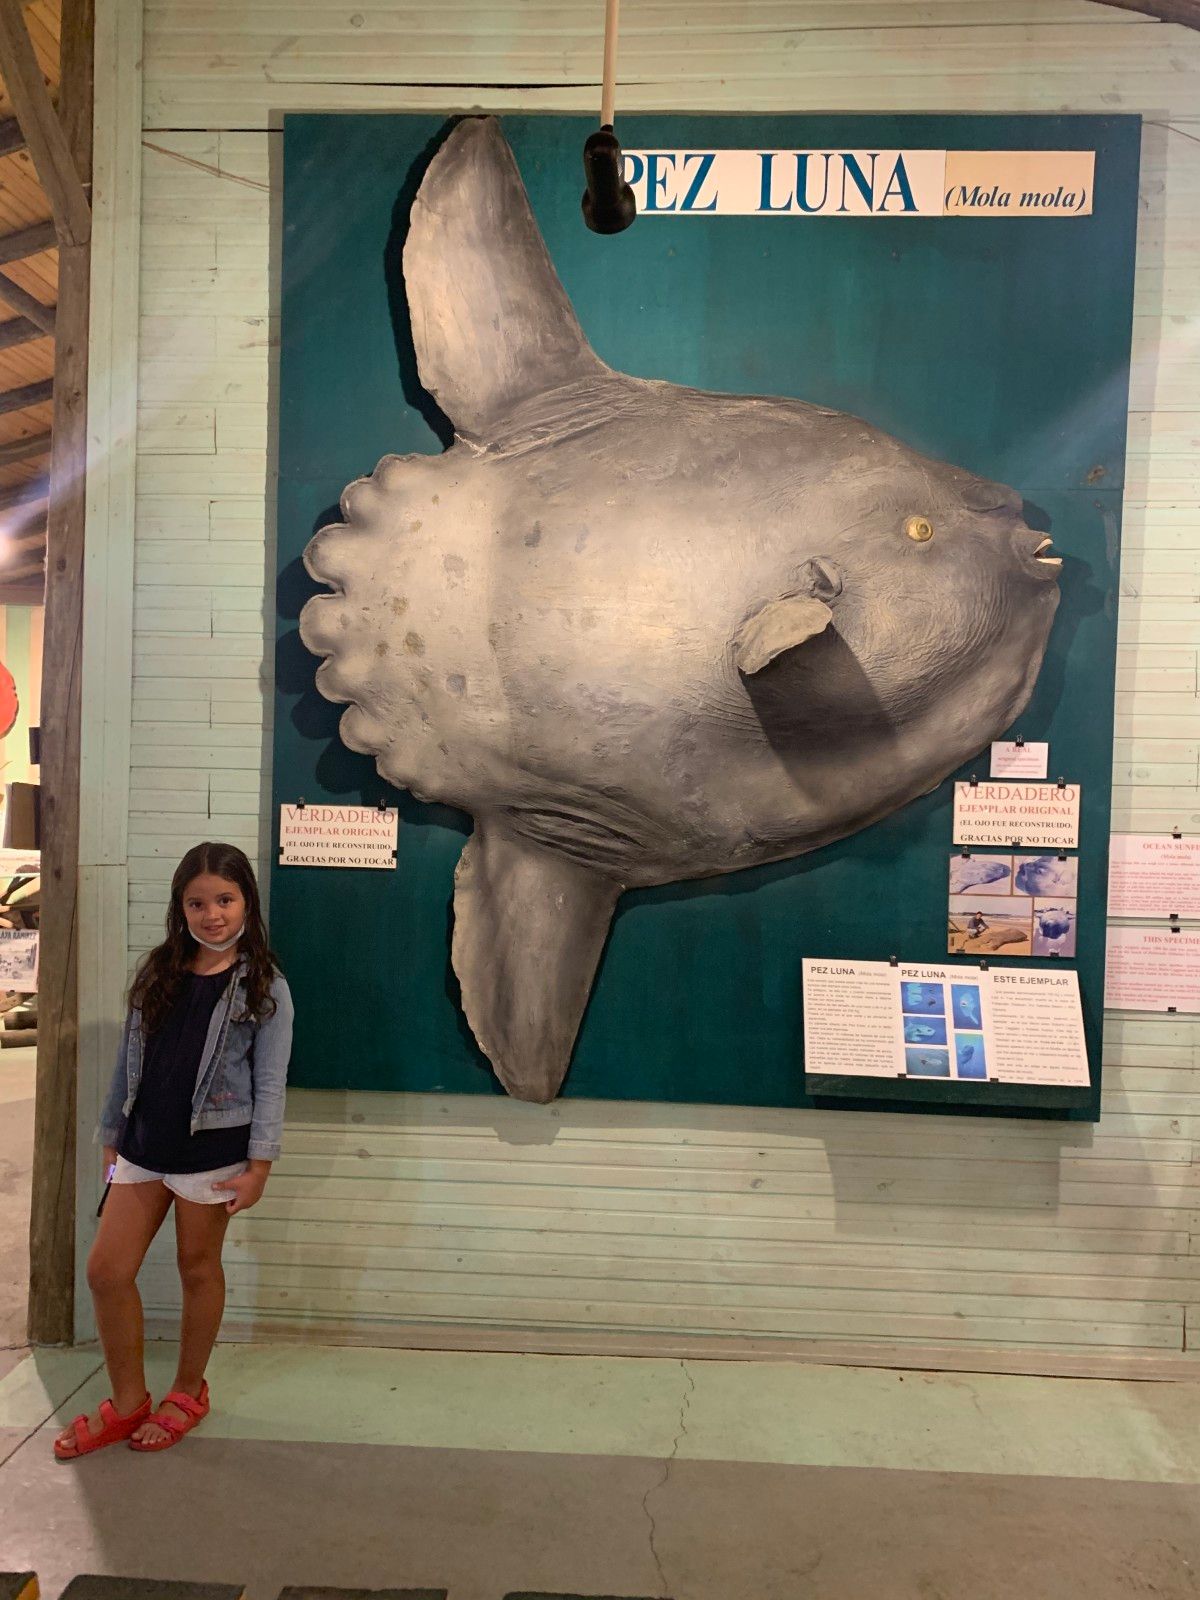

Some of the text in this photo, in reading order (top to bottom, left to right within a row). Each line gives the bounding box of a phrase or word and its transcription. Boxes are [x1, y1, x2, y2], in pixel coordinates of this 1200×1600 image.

[621, 152, 919, 213] PEZ LUNA
[945, 184, 1086, 211] (Mola mola)
[960, 785, 1075, 802] VERDADERO
[286, 807, 395, 824] VERDADERO
[959, 804, 1074, 816] EJEMPLAR ORIGINAL
[285, 825, 393, 838] EJEMPLAR ORIGINAL
[960, 834, 1075, 845] GRACIAS POR NO TOCAR
[286, 855, 326, 864] GRACIAS
[328, 856, 347, 864] POR
[363, 857, 394, 866] TOCAR
[1143, 935, 1162, 943] THIS
[810, 966, 828, 975] PEZ
[830, 967, 855, 976] LUNA
[901, 969, 919, 978] PEZ
[921, 970, 946, 979] LUNA
[993, 975, 1069, 986] ESTE EJEMPLAR
